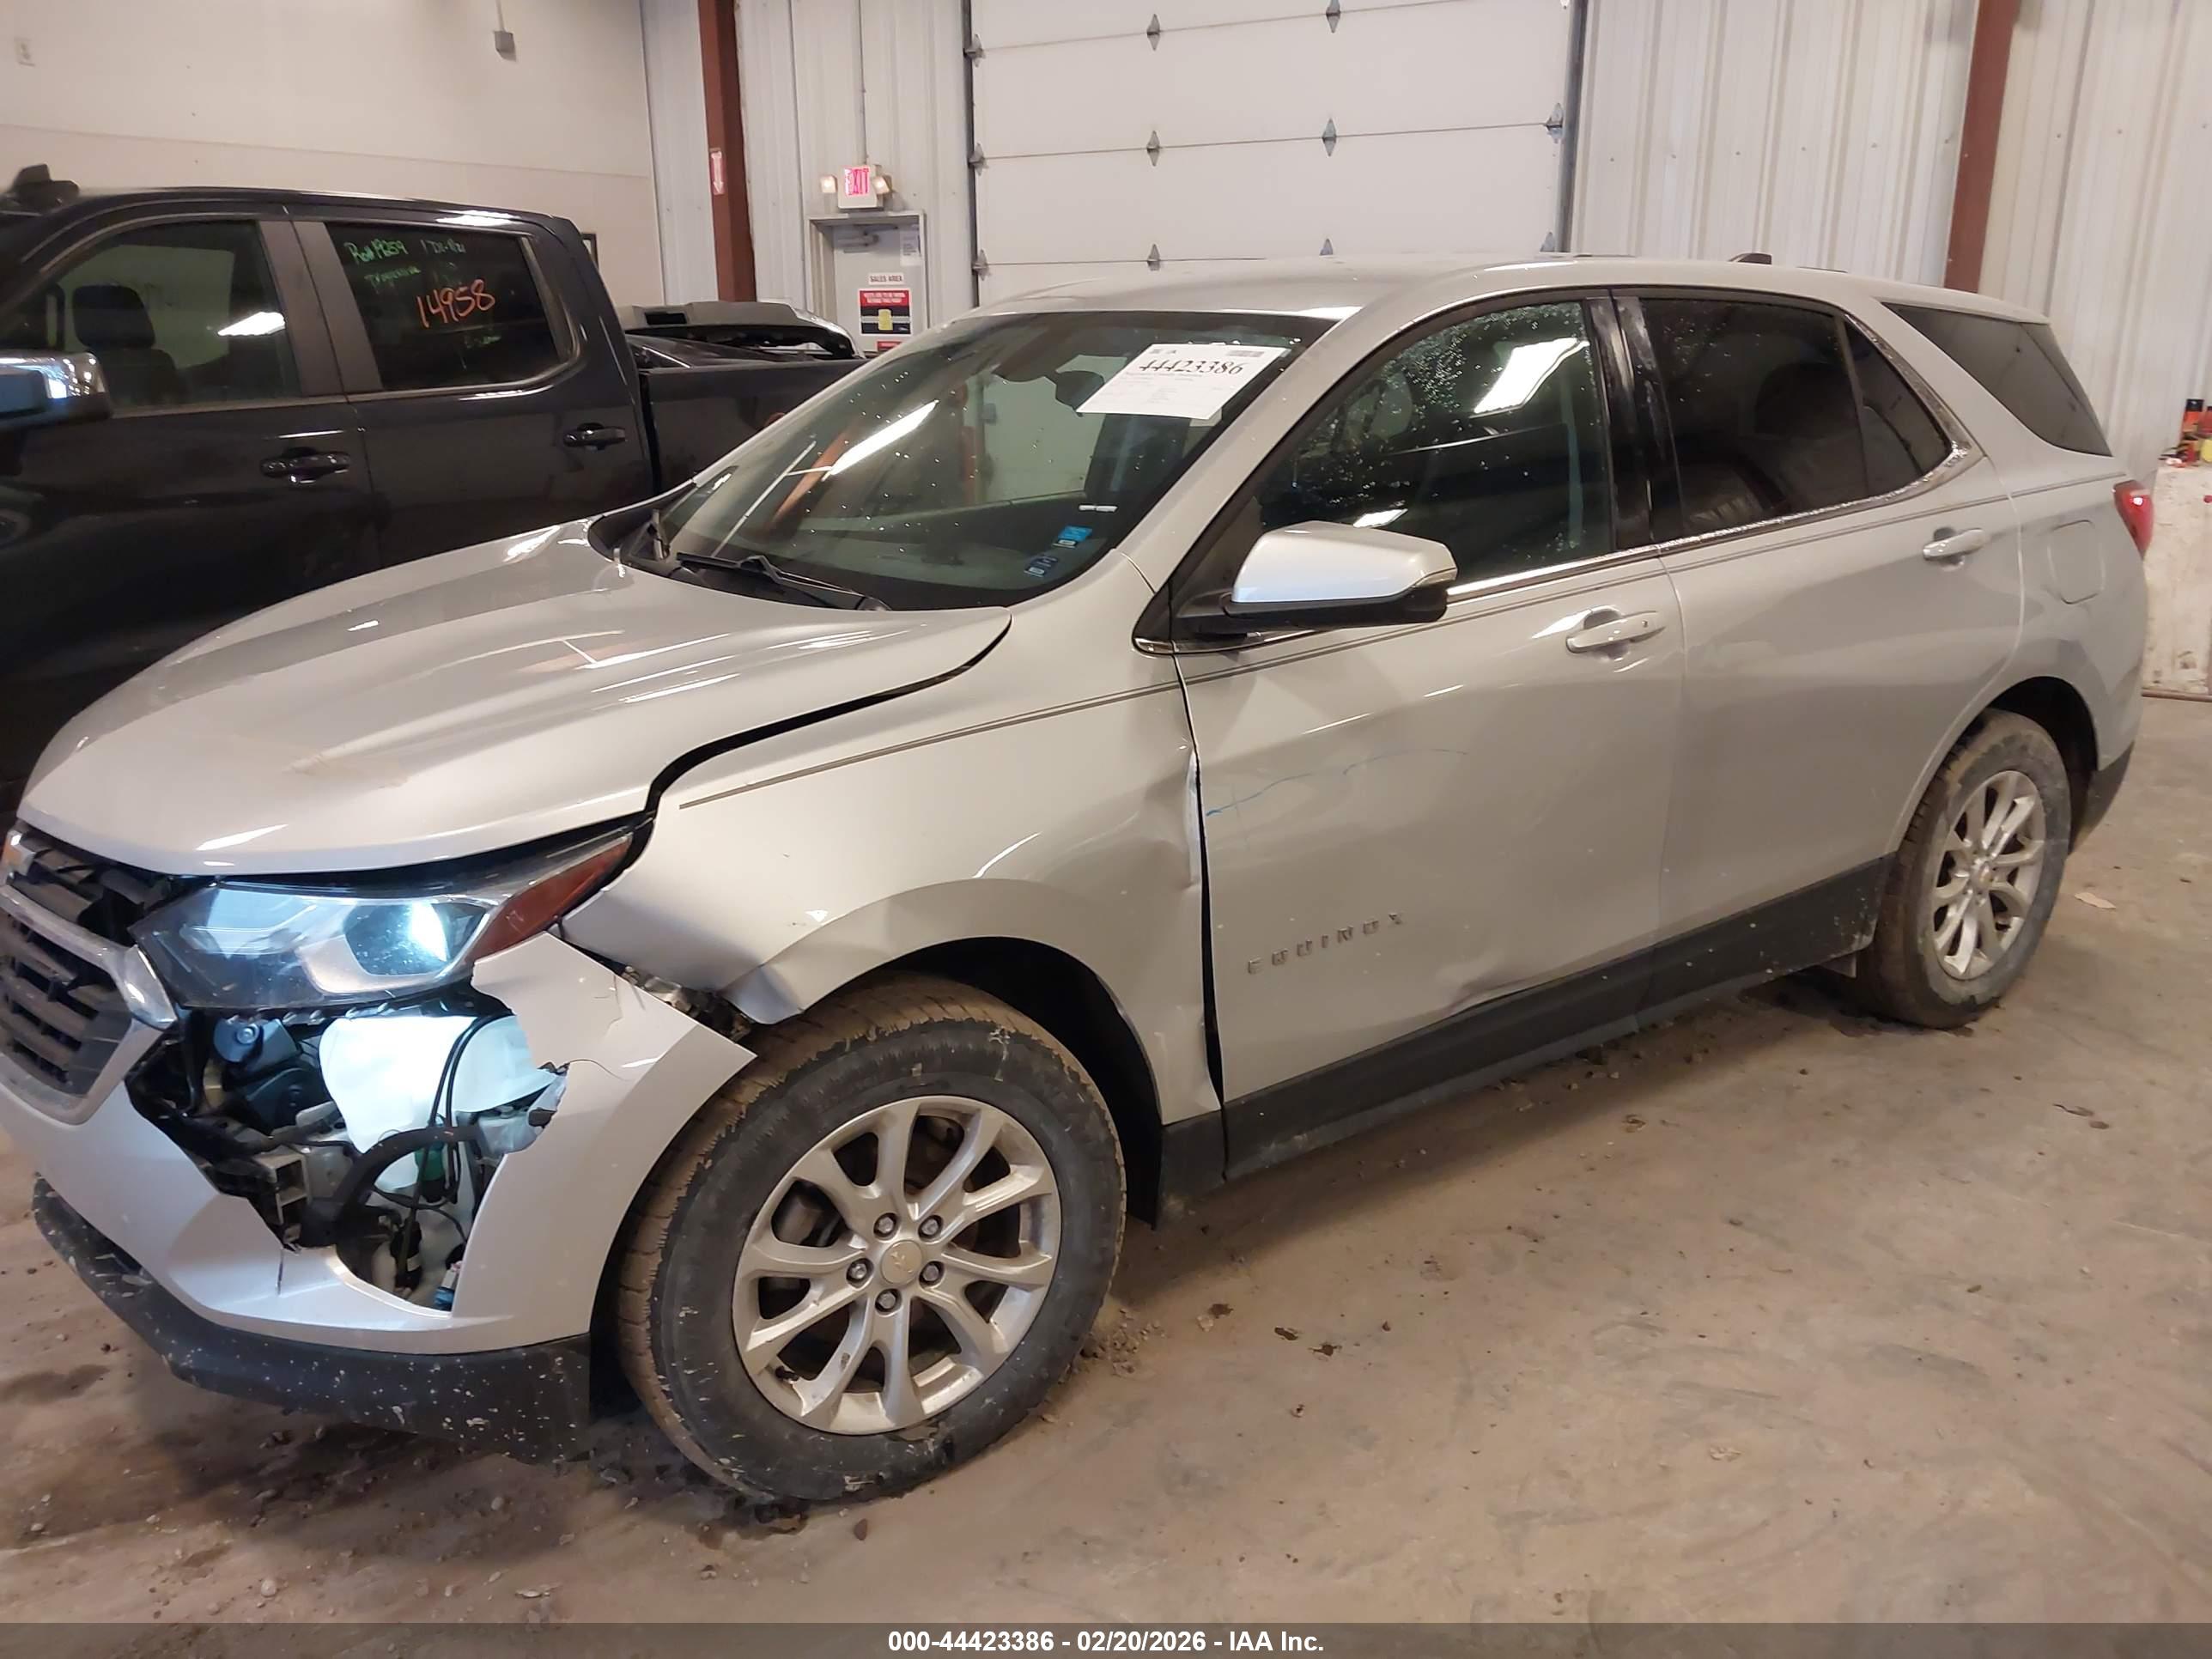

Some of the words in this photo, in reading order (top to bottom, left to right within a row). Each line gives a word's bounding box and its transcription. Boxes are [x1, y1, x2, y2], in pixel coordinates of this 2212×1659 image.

[416, 279, 495, 328] 14958
[1139, 359, 1249, 375] 44423386
[1248, 912, 1403, 975] EQUINOX
